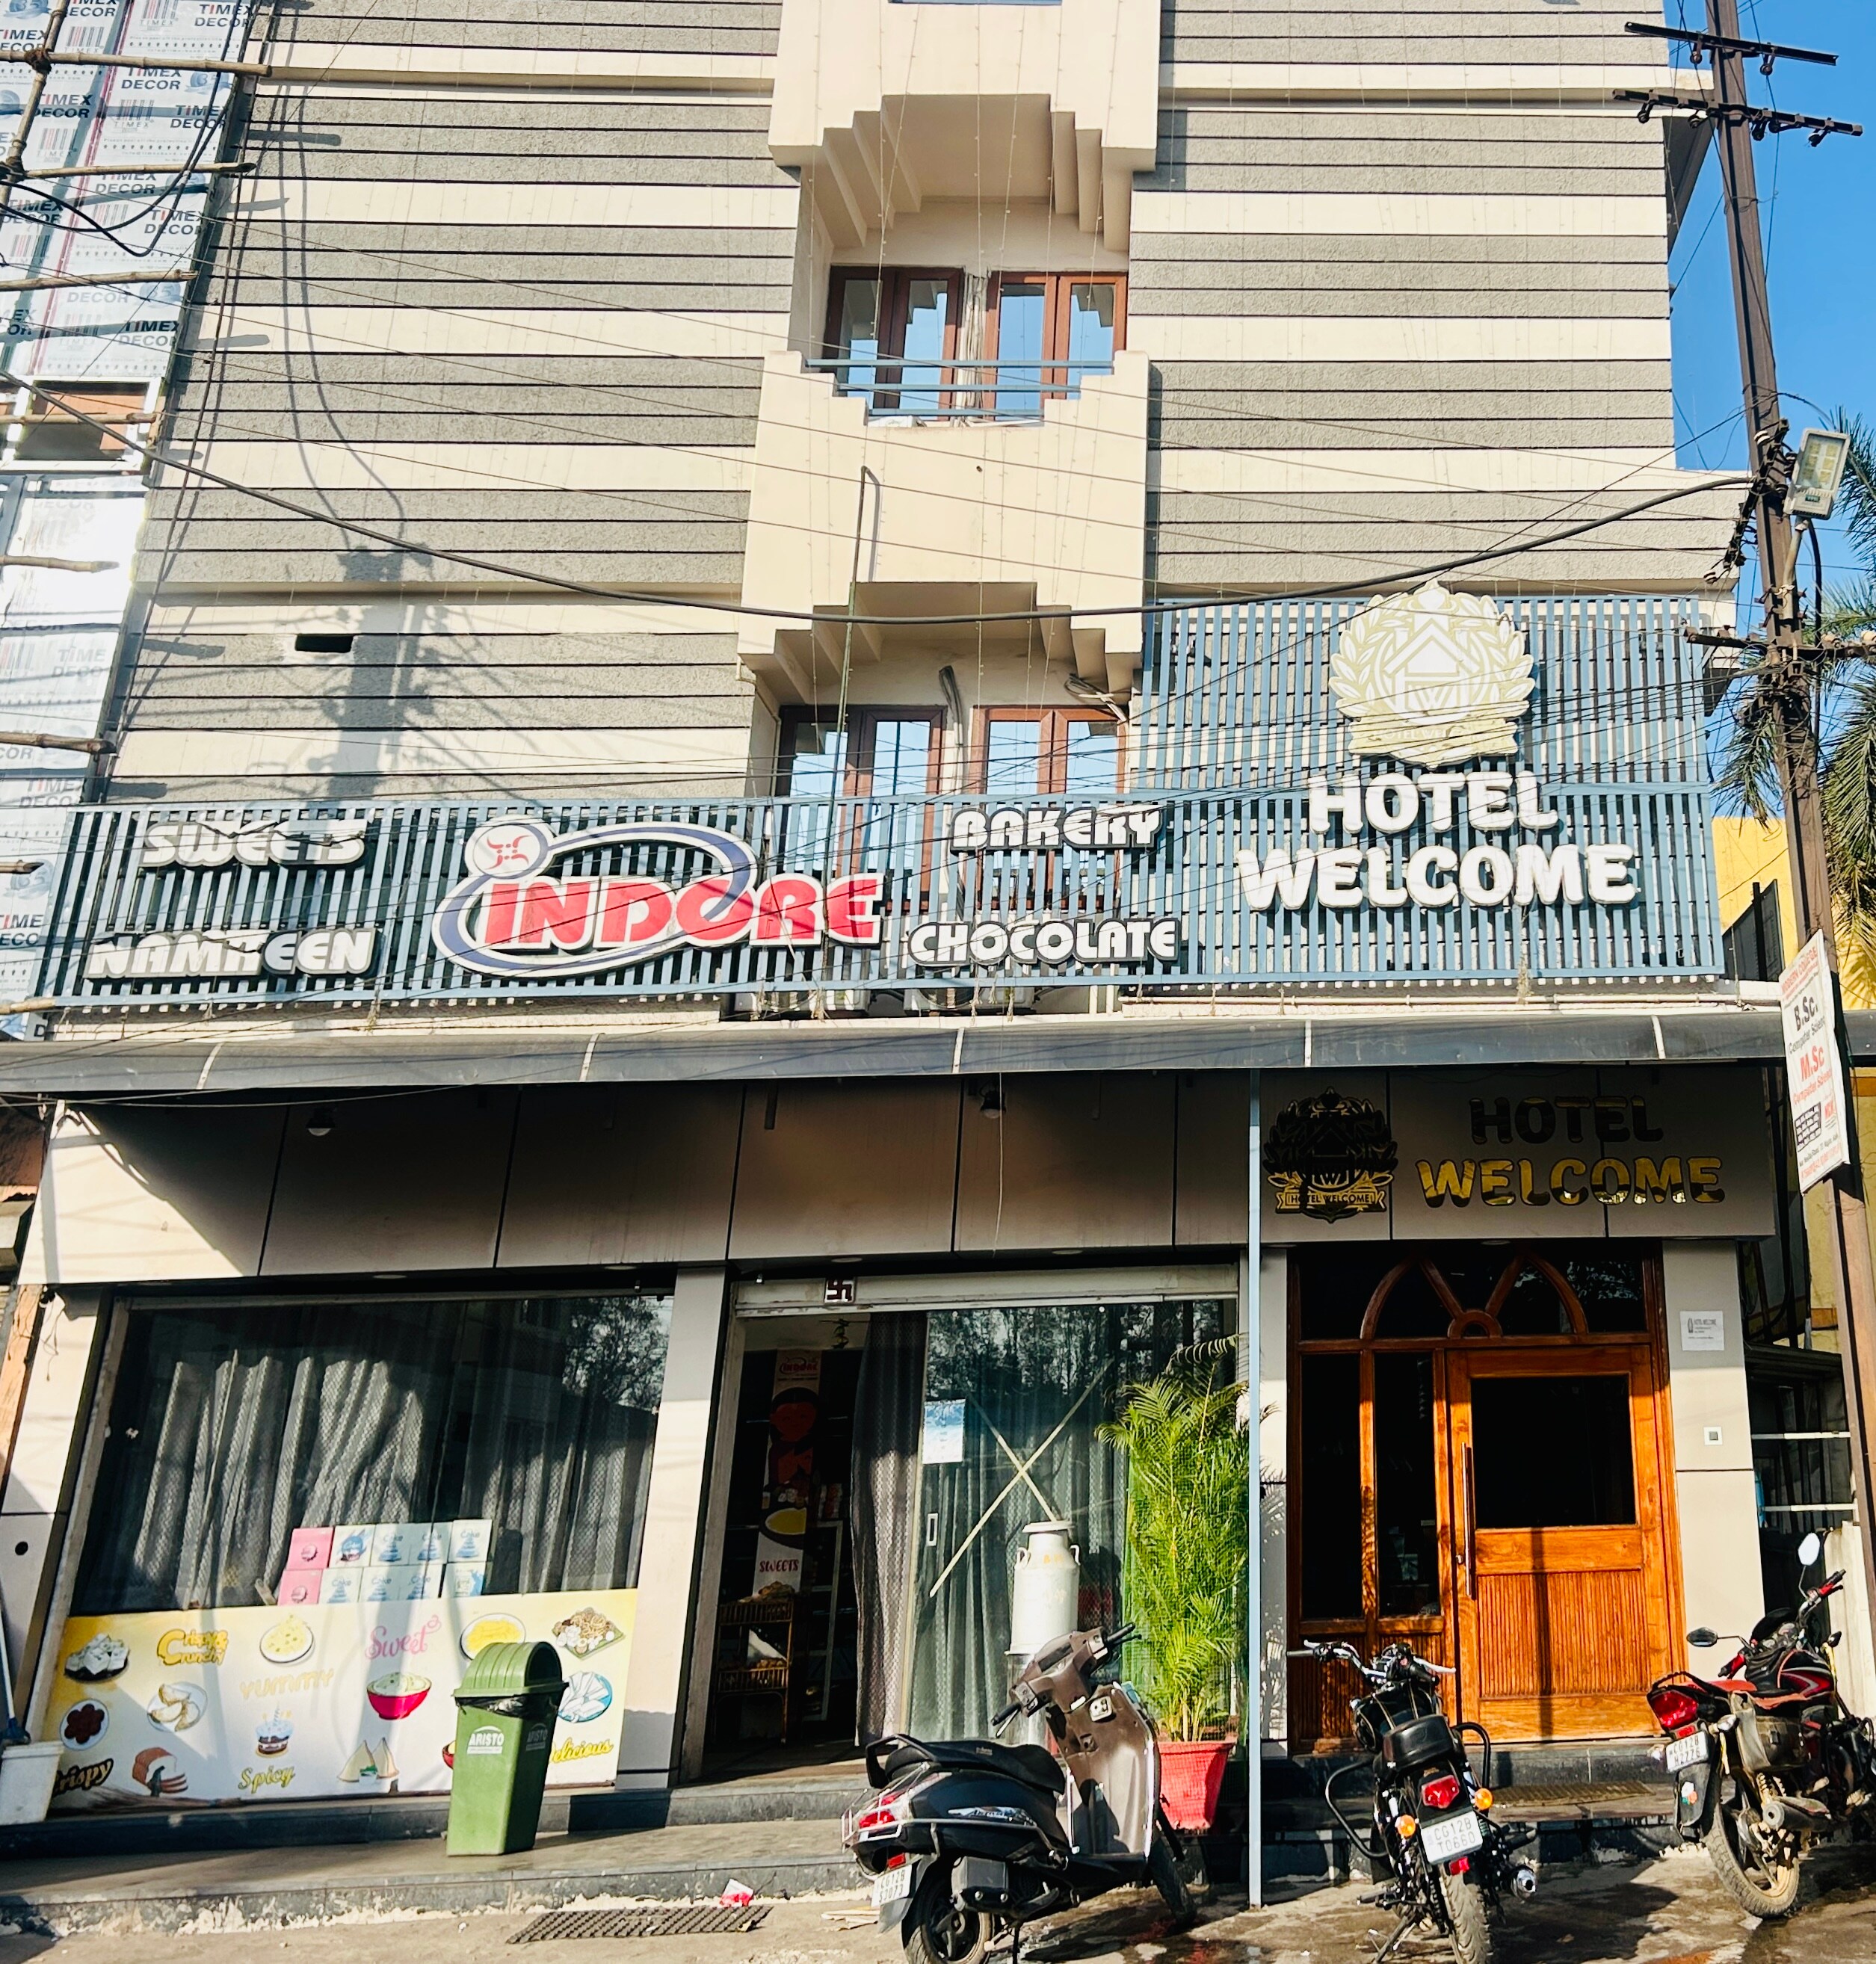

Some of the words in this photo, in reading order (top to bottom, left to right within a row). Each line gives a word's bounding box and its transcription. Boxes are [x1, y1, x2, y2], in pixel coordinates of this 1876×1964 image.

[70, 7, 116, 16] ECOR
[129, 68, 182, 77] TIMEX
[121, 80, 181, 90] DECOR
[176, 105, 226, 116] TIME
[96, 184, 155, 194] DECOR
[67, 292, 129, 303] DECOR
[58, 649, 106, 661] TIME
[52, 666, 102, 677] DECO
[28, 779, 75, 792] TIME
[19, 796, 72, 807] DECO
[1308, 771, 1558, 833] HOTEL
[951, 806, 1164, 850] BAKERY
[140, 820, 367, 867] SWEETS
[1236, 843, 1635, 910] WELCOME
[467, 852, 884, 954] INDORE
[908, 918, 1180, 966] CHOCOLATE
[1469, 1096, 1663, 1144] HOTEL
[1416, 1157, 1725, 1208] WELCOME
[1292, 1193, 1321, 1202] HTEL
[759, 1560, 799, 1572] SWEETS
[365, 1615, 441, 1660] Sweet
[469, 1732, 505, 1747] ARISTO
[550, 1736, 614, 1764] elicious
[54, 1758, 114, 1797] rispy
[238, 1764, 296, 1794] Spicy
[1434, 1817, 1472, 1841] CG12B
[1437, 1831, 1475, 1854] T0660
